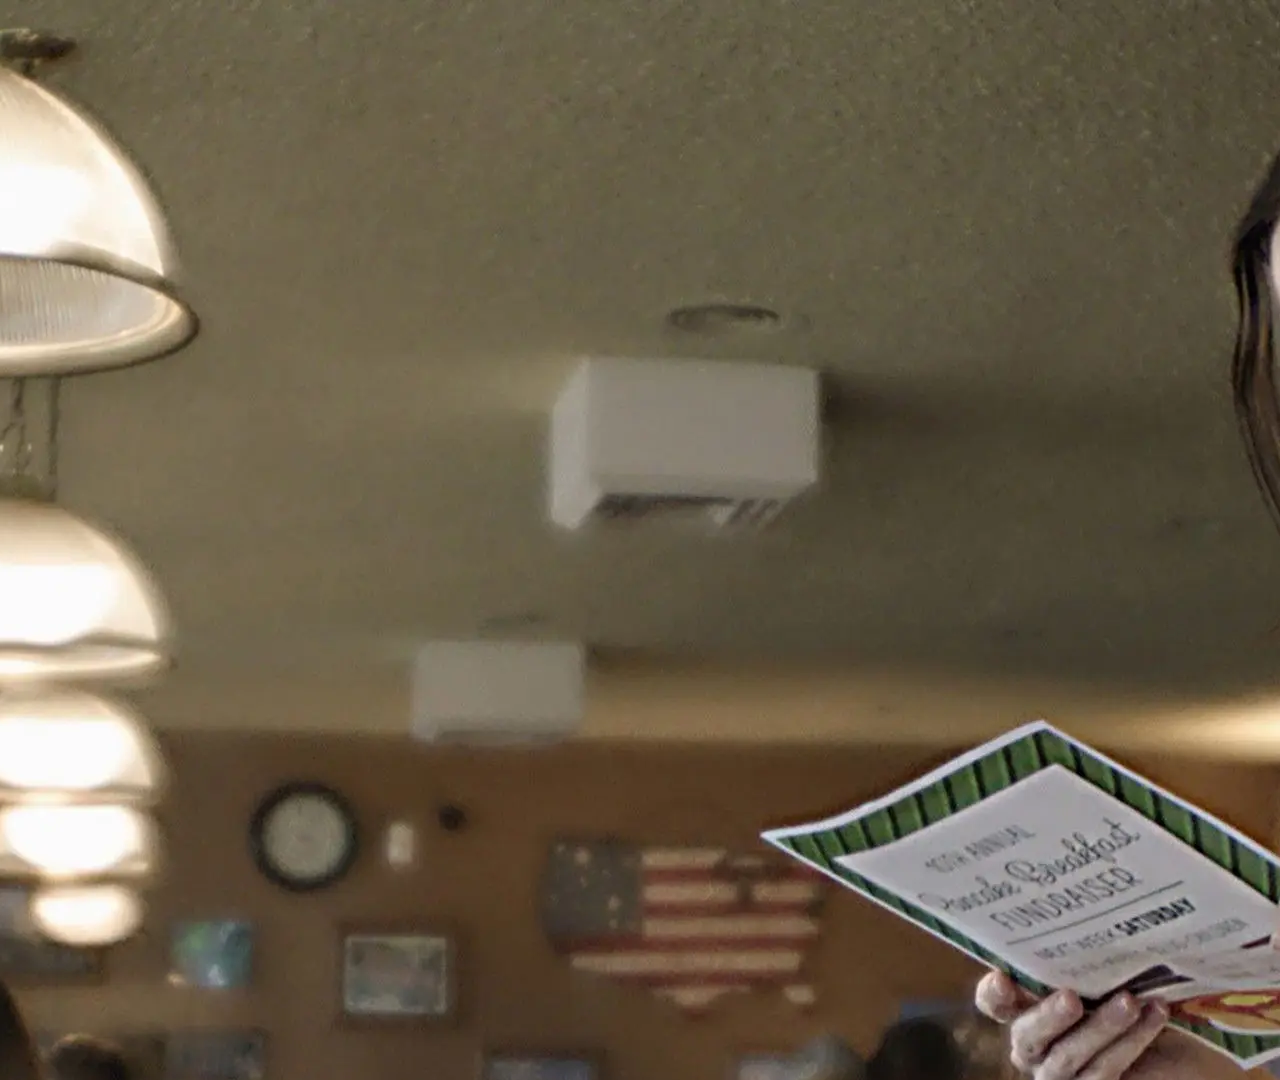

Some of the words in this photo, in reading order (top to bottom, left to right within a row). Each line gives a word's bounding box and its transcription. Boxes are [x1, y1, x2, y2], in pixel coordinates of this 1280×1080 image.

[964, 824, 1037, 862] ANNUAL
[1004, 816, 1142, 887] Breakfast
[989, 867, 1143, 931] FUNDRAISER
[1114, 895, 1197, 937] SATURDAY
